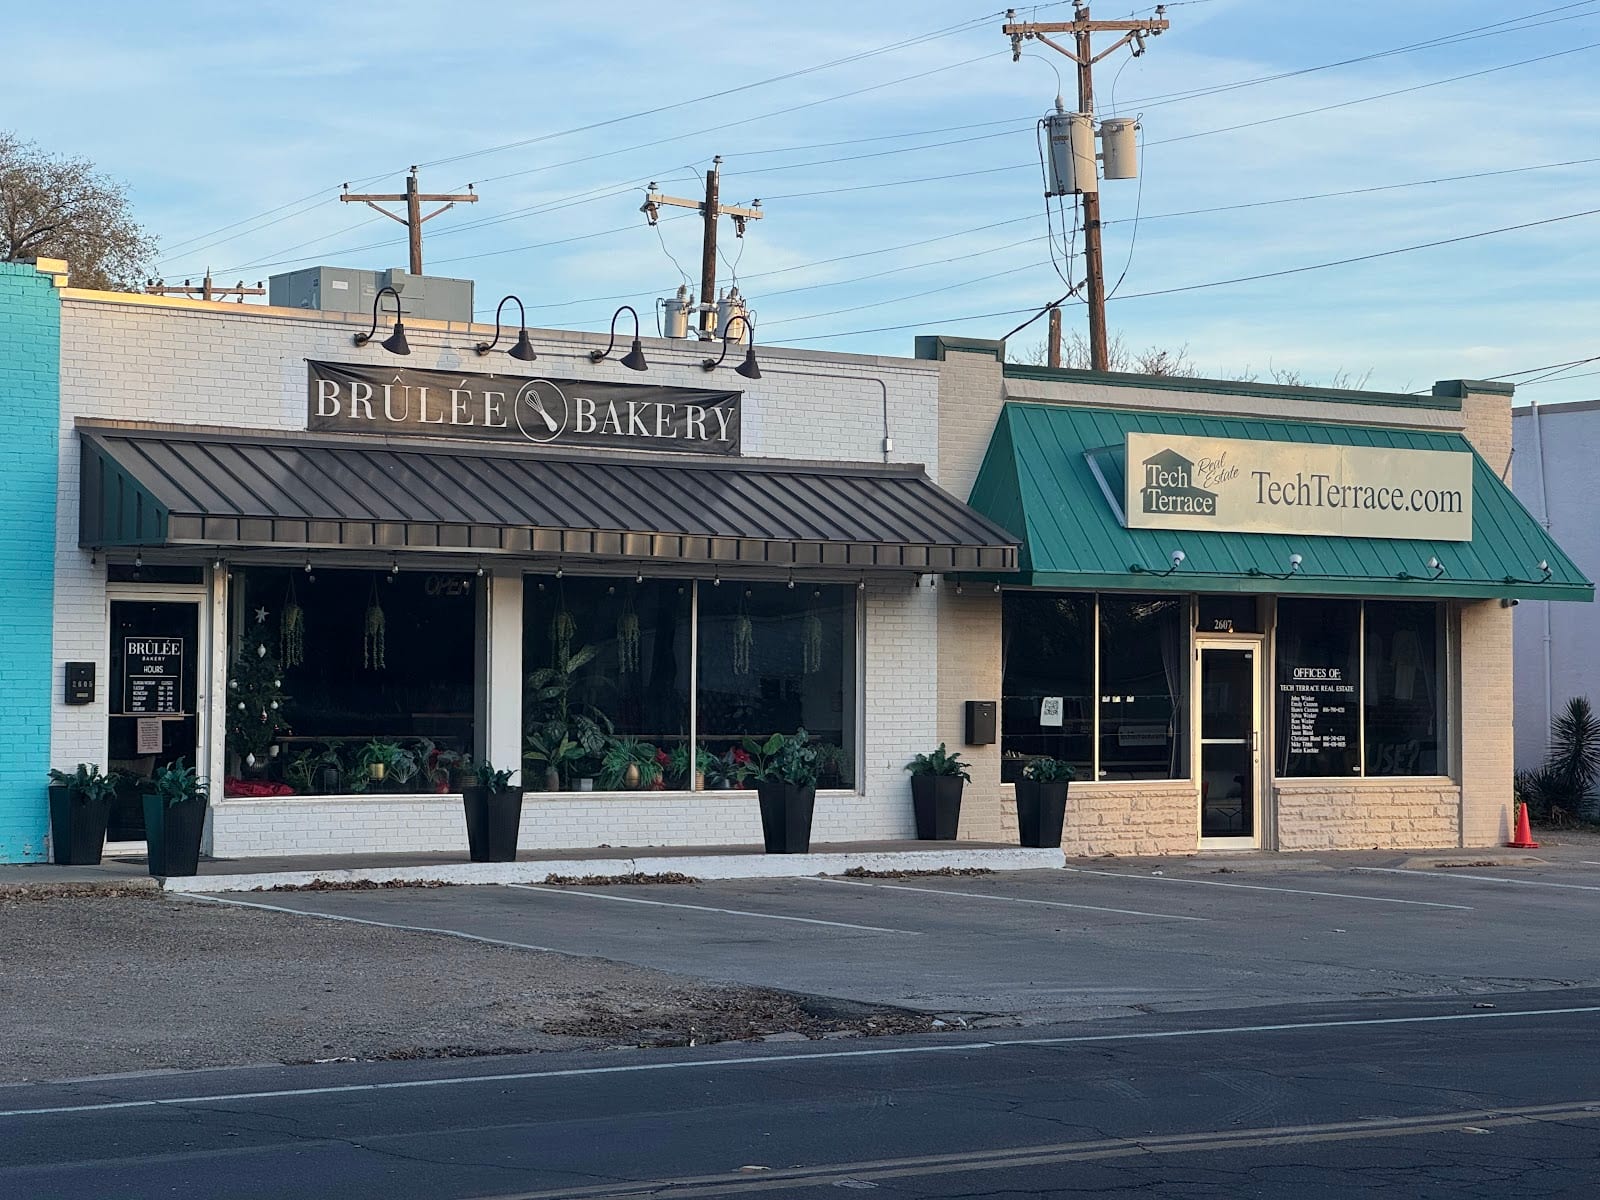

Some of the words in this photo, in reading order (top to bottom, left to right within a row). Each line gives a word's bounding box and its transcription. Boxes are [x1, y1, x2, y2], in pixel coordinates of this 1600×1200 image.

[315, 375, 507, 428] BRÛLÉE
[573, 398, 735, 442] BAKERY
[1198, 451, 1226, 477] Real
[1147, 465, 1188, 488] Tech
[1203, 465, 1240, 488] Estate
[1147, 489, 1213, 513] Terrace
[1251, 471, 1463, 513] TechTerrace.com
[1214, 619, 1232, 630] 2607
[128, 639, 180, 656] BRÛLÉE
[143, 665, 164, 674] HOURS
[1293, 667, 1327, 678] OFFICES
[1280, 684, 1295, 692] TECH
[1295, 684, 1320, 692] TERRACE
[1320, 685, 1335, 693] REAL
[1335, 685, 1354, 693] ESTATE
